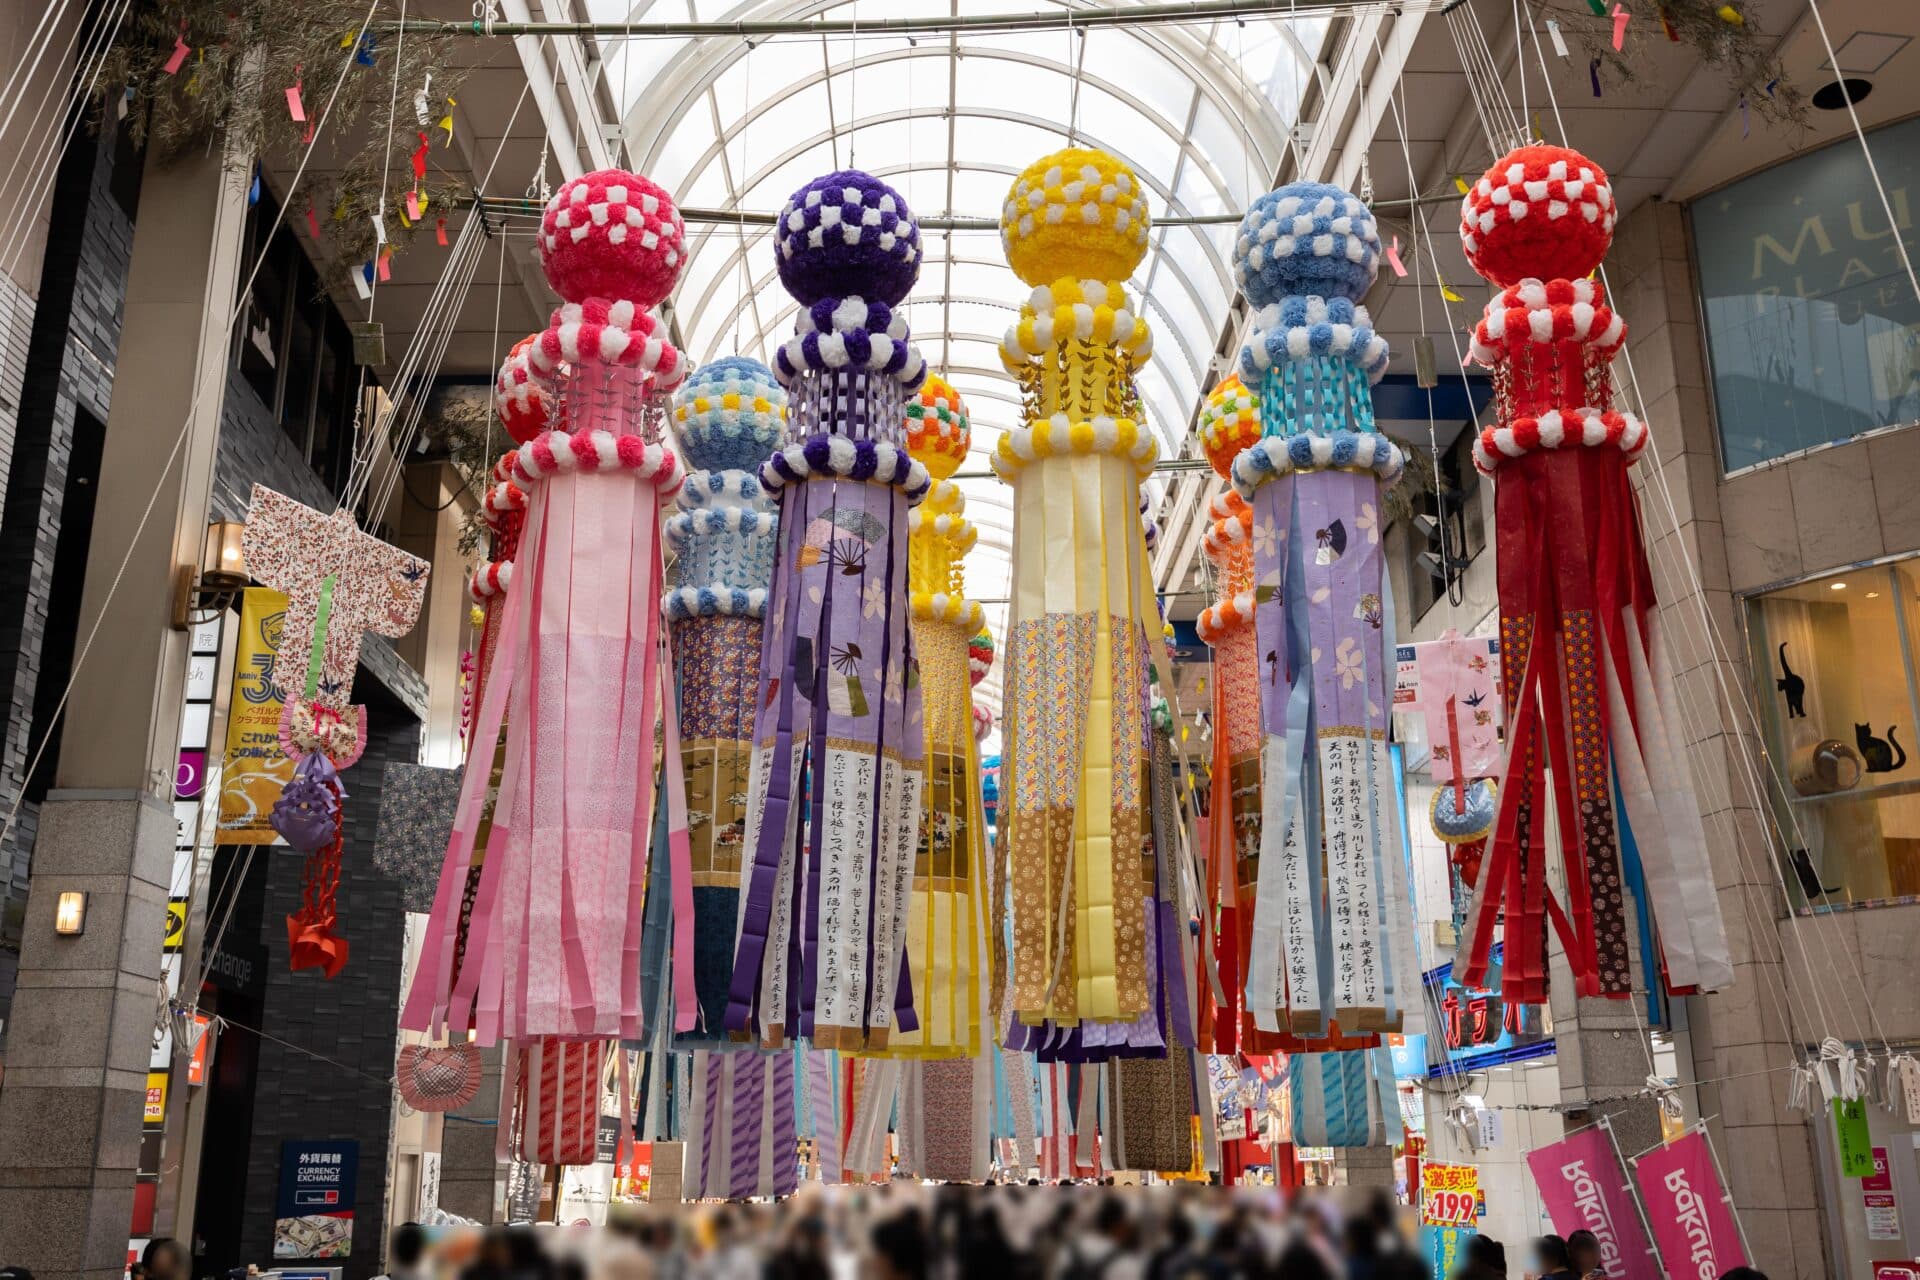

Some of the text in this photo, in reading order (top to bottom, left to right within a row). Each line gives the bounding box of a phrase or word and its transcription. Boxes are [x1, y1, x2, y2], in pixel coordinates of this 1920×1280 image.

[1329, 741, 1342, 770] 天の川
[826, 867, 841, 895] 天の川
[299, 1153, 342, 1164] 外貨両替
[297, 1174, 340, 1182] EXCHANGE
[298, 1167, 340, 1175] CURRENCY
[1427, 1192, 1474, 1221] ¥199
